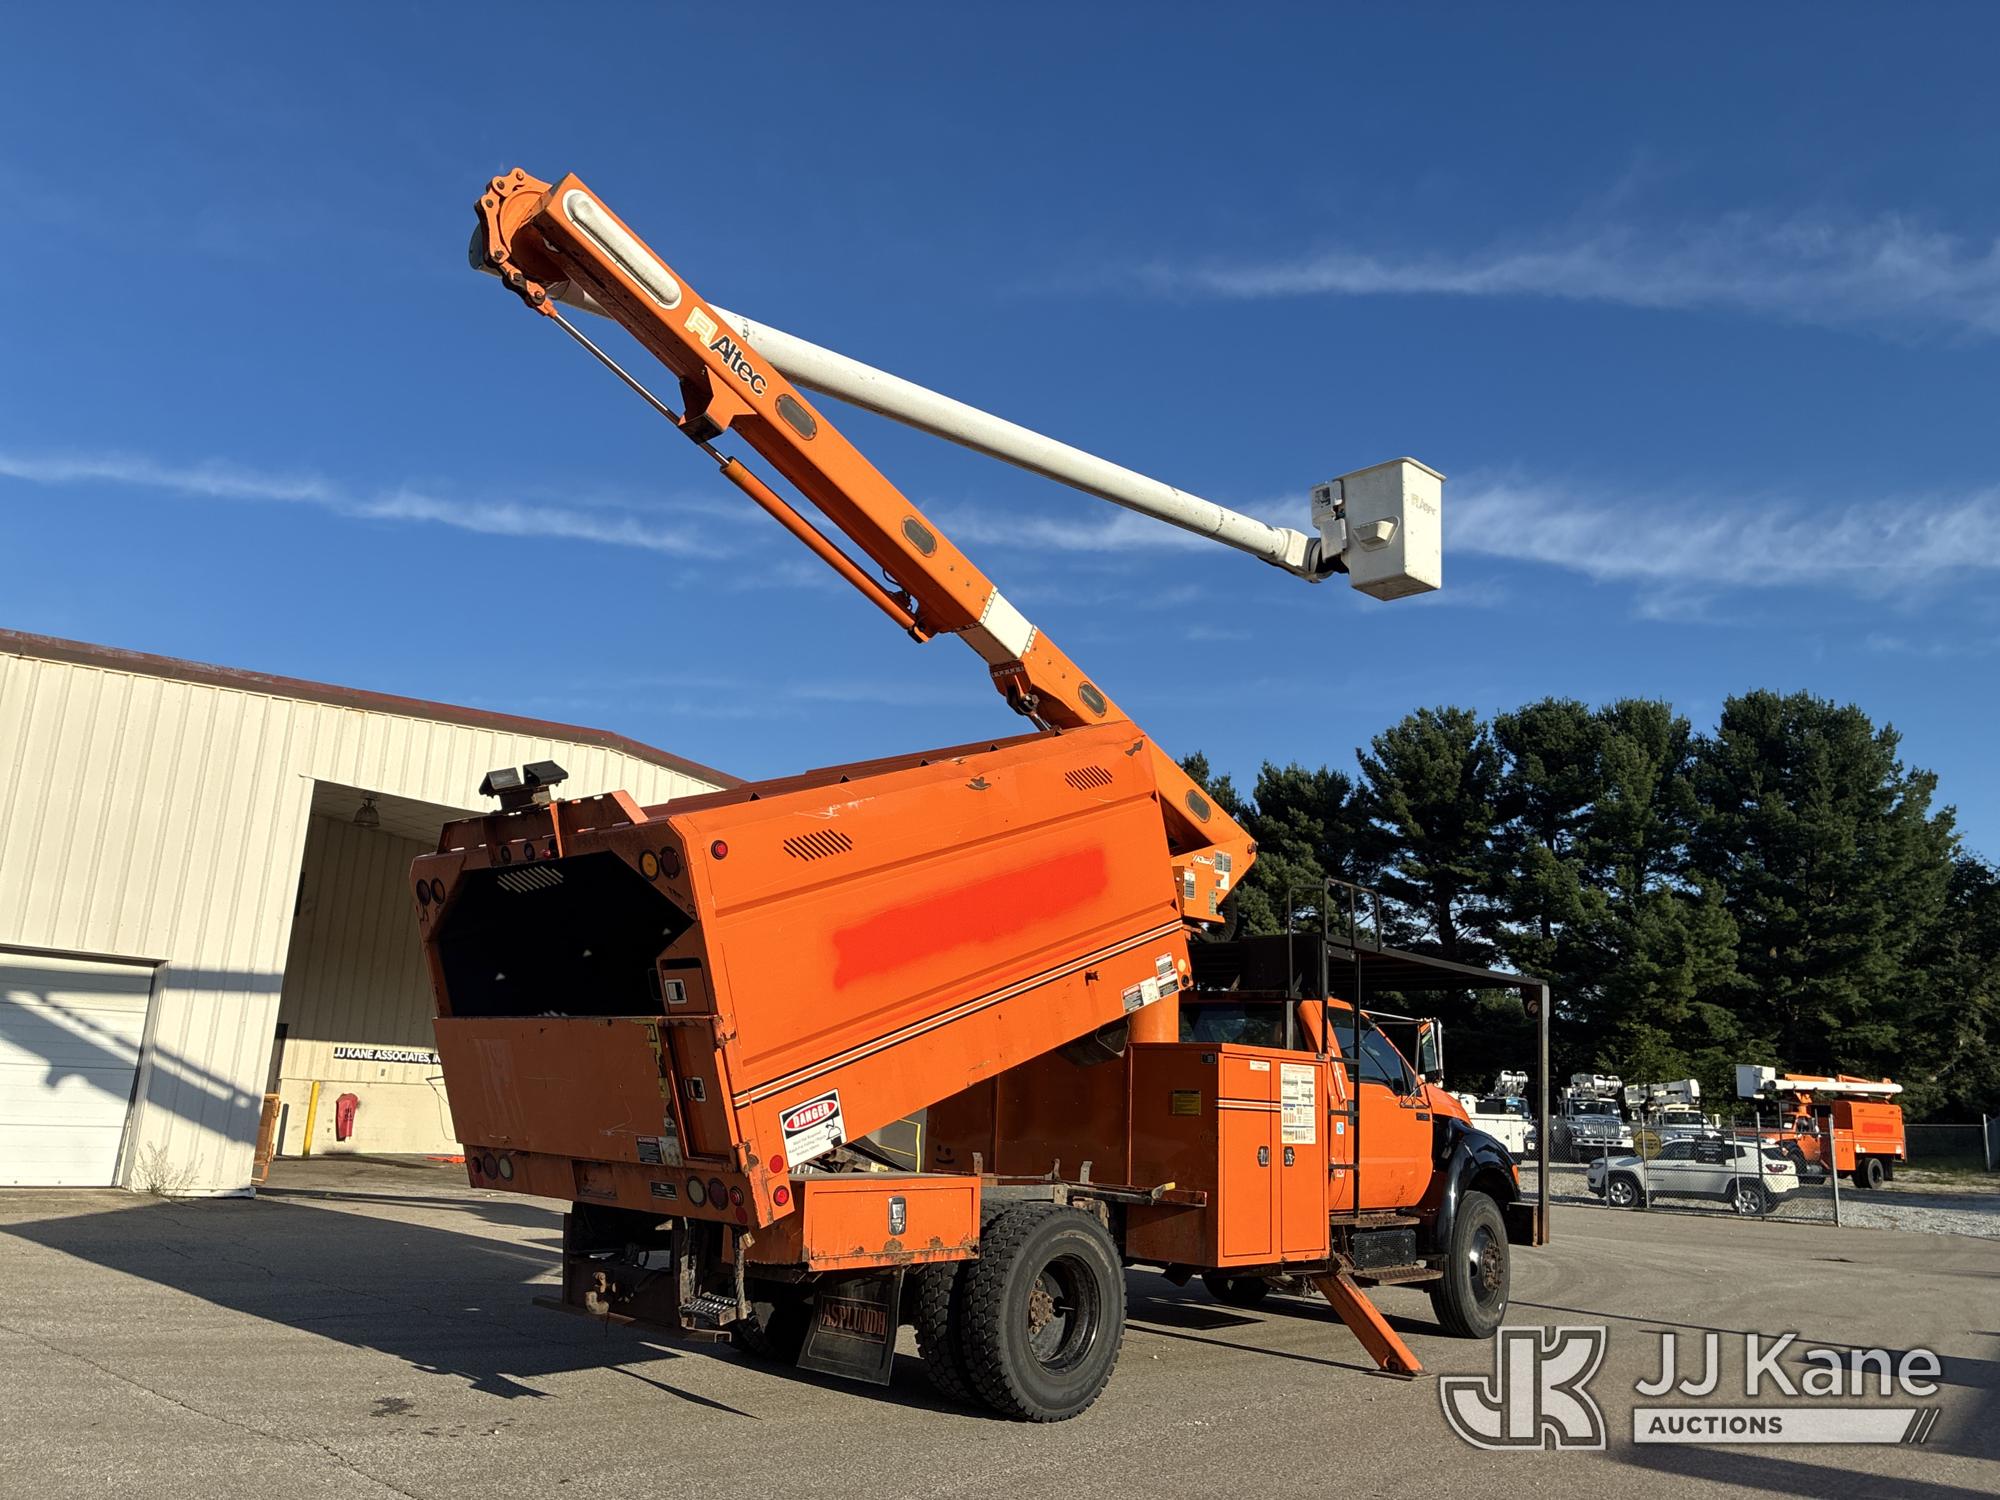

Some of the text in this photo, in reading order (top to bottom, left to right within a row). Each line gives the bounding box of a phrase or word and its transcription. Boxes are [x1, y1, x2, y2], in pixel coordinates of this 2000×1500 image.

[709, 335, 767, 395] Altec
[334, 1047, 345, 1058] JJ
[346, 1048, 374, 1060] KANE
[374, 1050, 431, 1064] ASSOCIATES,
[792, 1102, 830, 1129] DANGER
[821, 1303, 887, 1336] ASPLUNDH
